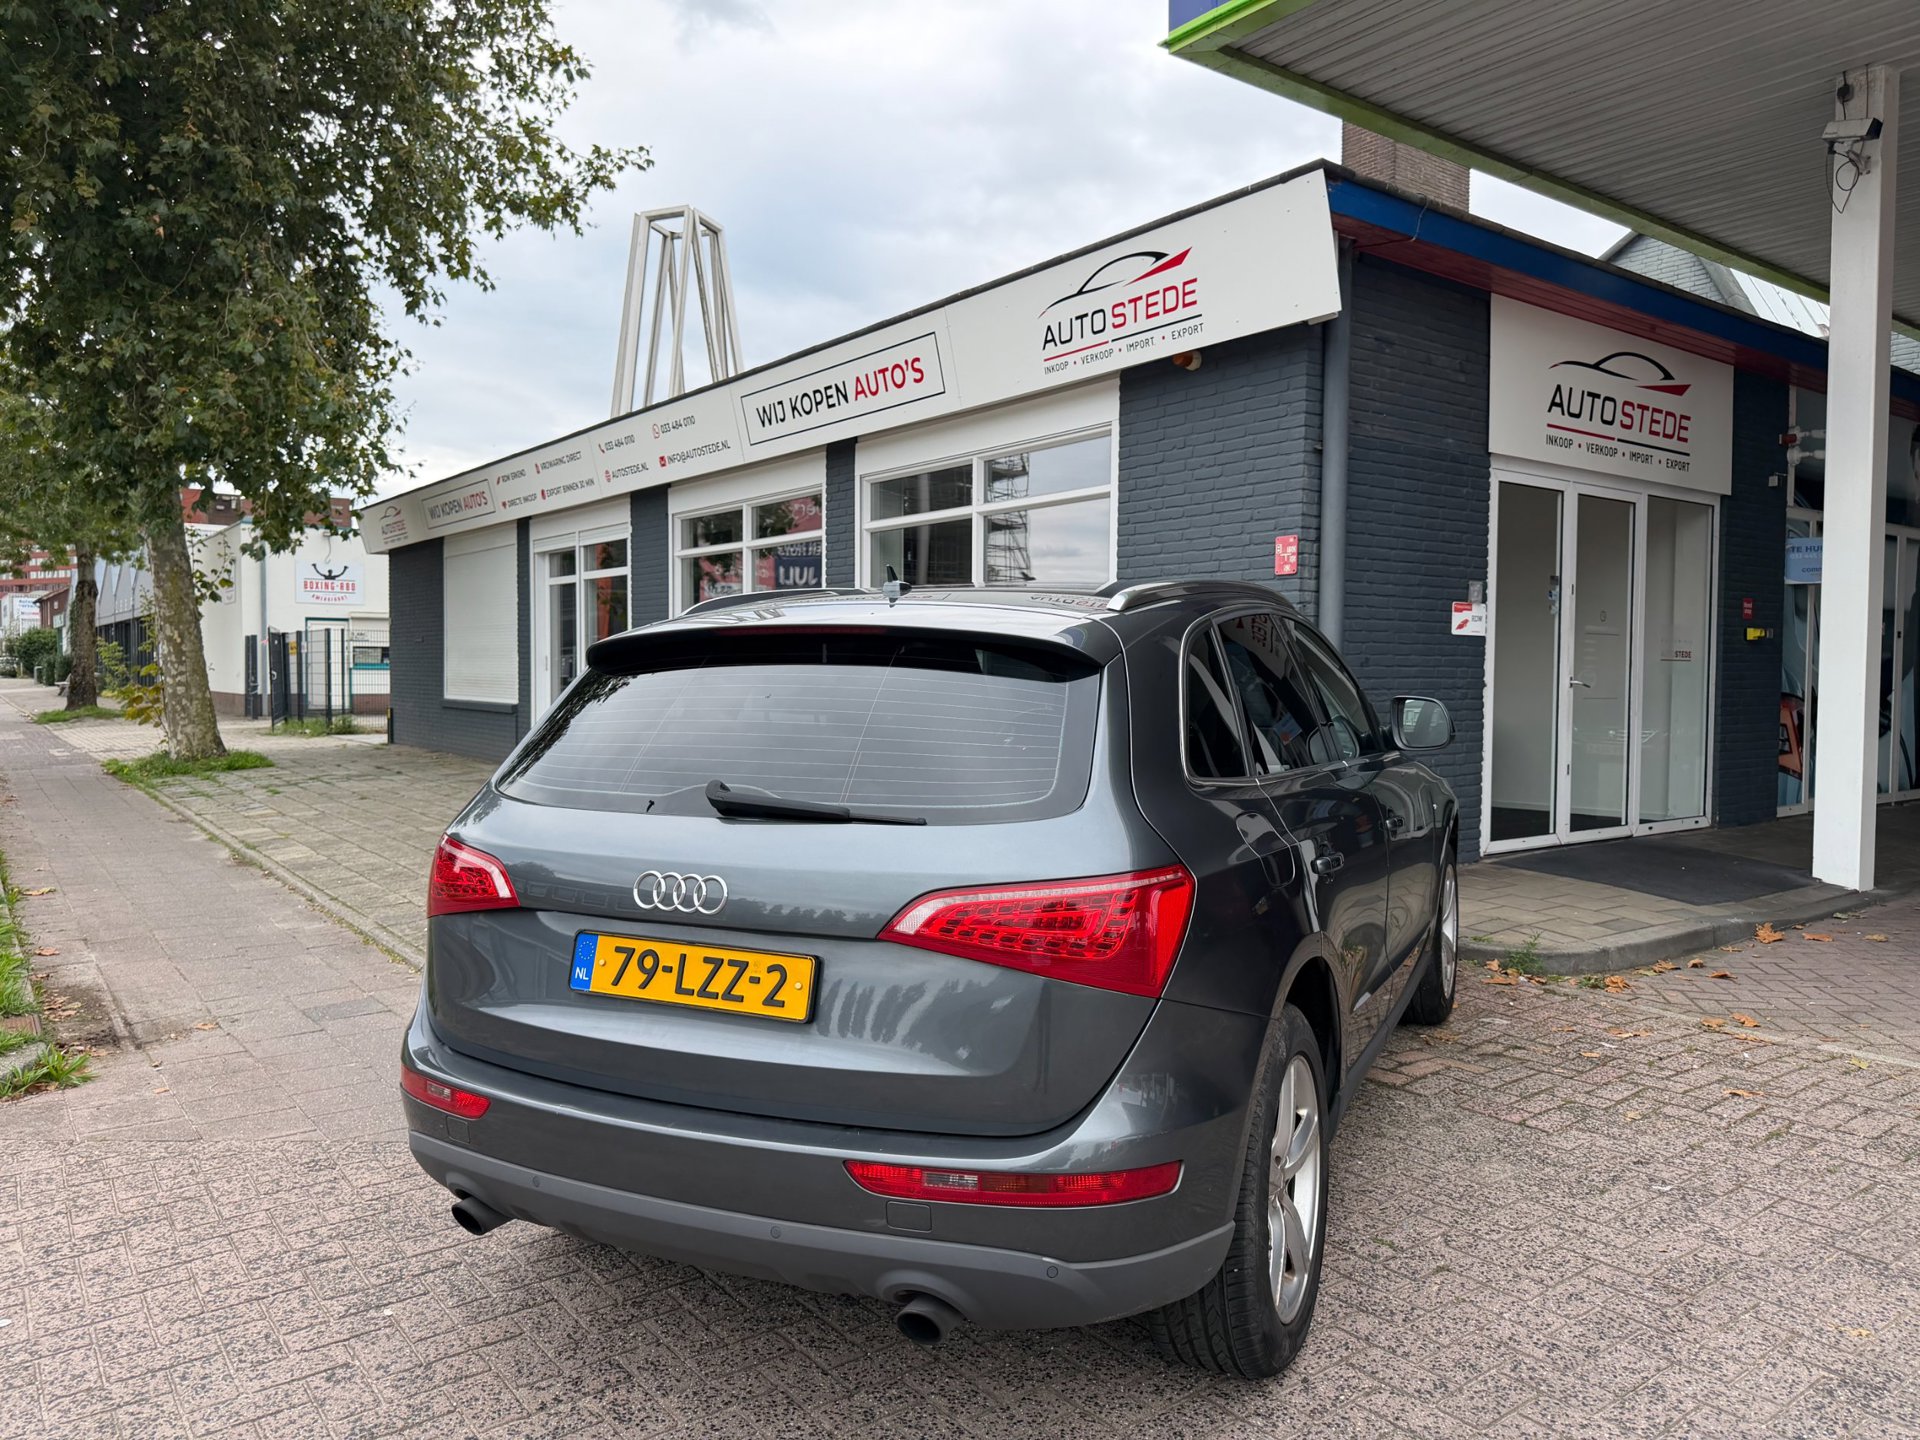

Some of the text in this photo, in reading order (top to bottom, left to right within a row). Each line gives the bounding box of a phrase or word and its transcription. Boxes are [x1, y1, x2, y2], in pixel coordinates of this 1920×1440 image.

[1042, 277, 1198, 351] AUTOSTEDE
[1044, 323, 1204, 375] INKOOP VERKOOP IMPORT EXPORT
[756, 357, 925, 428] WIJ KOPEN AUTO'S
[1547, 384, 1692, 443] AUTOSTEDE
[1546, 434, 1691, 473] INKOOP VERKOOP IMPORT EXPORT
[441, 498, 463, 517] KOPEN
[574, 966, 589, 981] NL
[611, 945, 788, 1008] 79-LZZ-2
